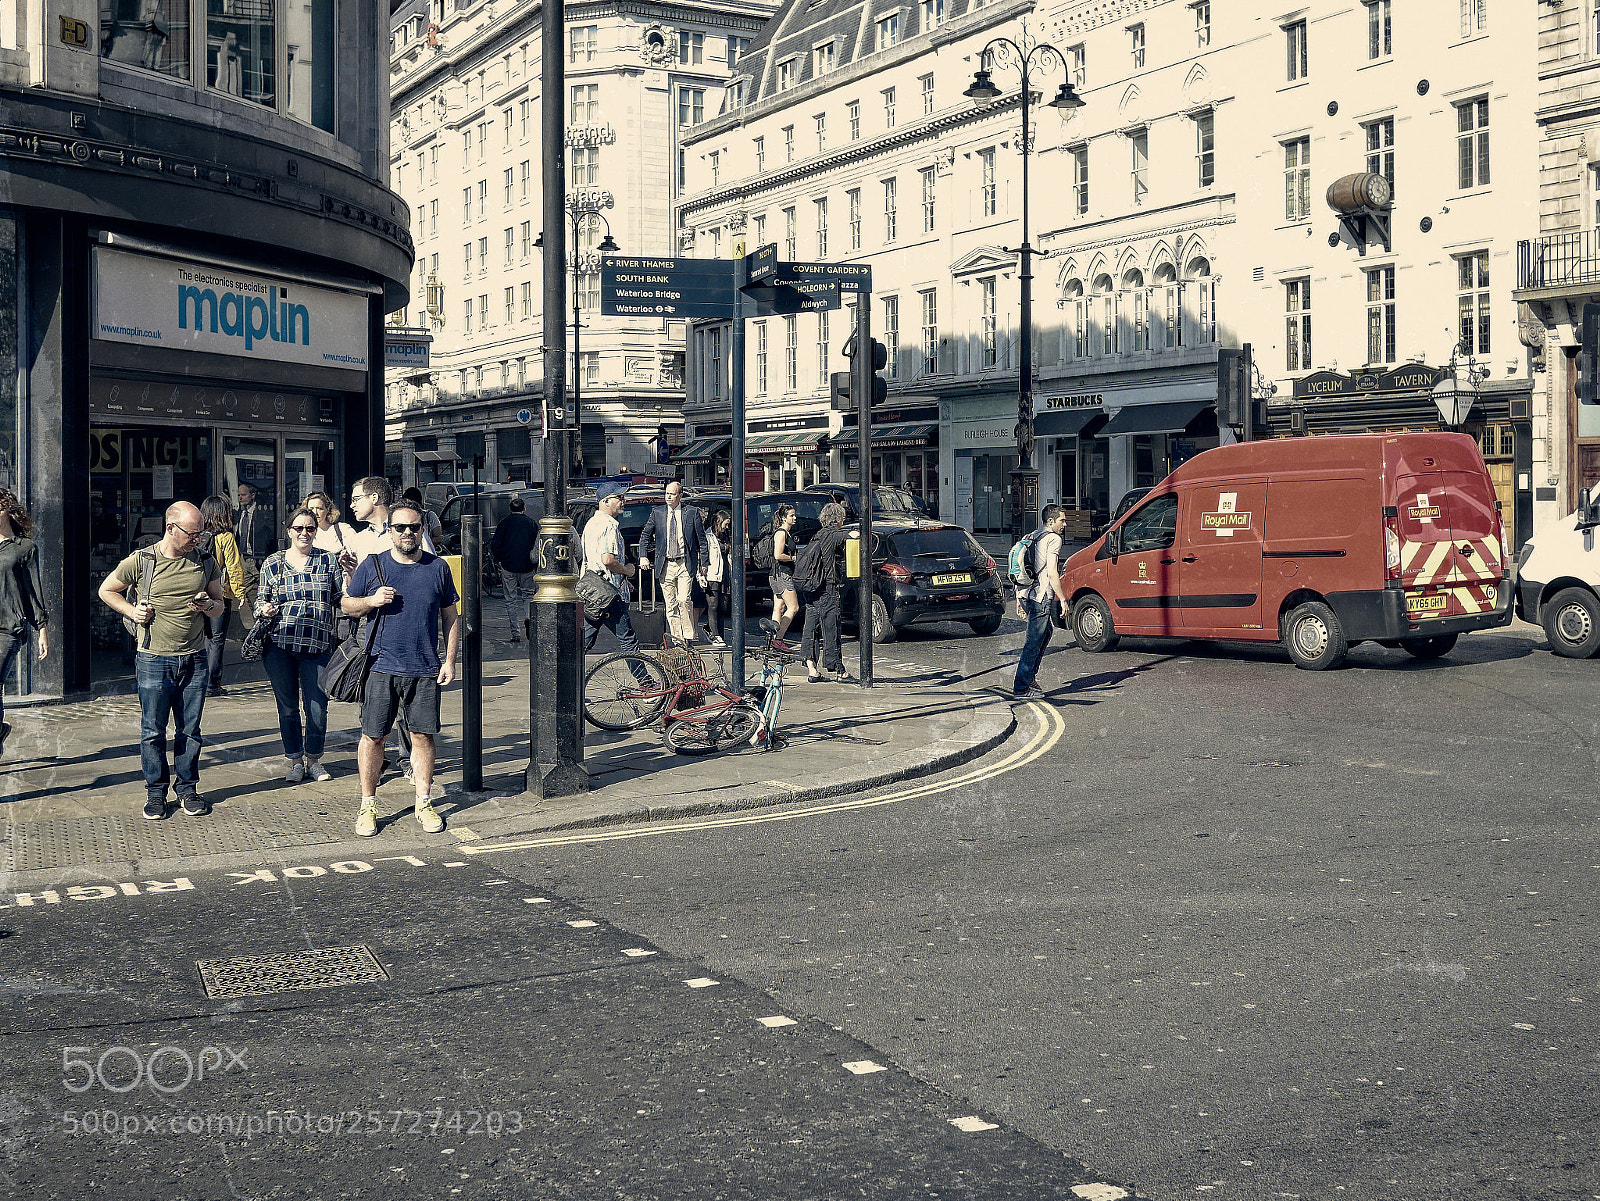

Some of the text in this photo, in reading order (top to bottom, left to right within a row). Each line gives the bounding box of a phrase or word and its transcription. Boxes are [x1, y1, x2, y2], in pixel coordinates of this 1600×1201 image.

[615, 260, 675, 269] RIVER THAMES
[792, 265, 859, 275] COVENT GARDEN
[177, 268, 268, 295] The electronics specialist
[615, 274, 670, 284] SOUTH BANK
[797, 283, 828, 294] HOLBORN
[840, 282, 859, 290] azza
[615, 288, 681, 300] Waterloo Bridge
[615, 304, 654, 313] Waterloo
[800, 298, 828, 309] Aldwych
[178, 284, 310, 351] maplin
[100, 323, 162, 340] www.maplin.co.uk
[385, 343, 427, 356] maplin
[1307, 373, 1432, 393] LYCEUM TAVERN
[1046, 393, 1103, 409] STARBUCKS
[989, 428, 1008, 438] HOUSE
[1411, 507, 1438, 518] Royal Mail
[1204, 514, 1247, 527] Royal Mail
[1409, 598, 1429, 609] KY65
[0, 856, 429, 909] LOOK RIGH
